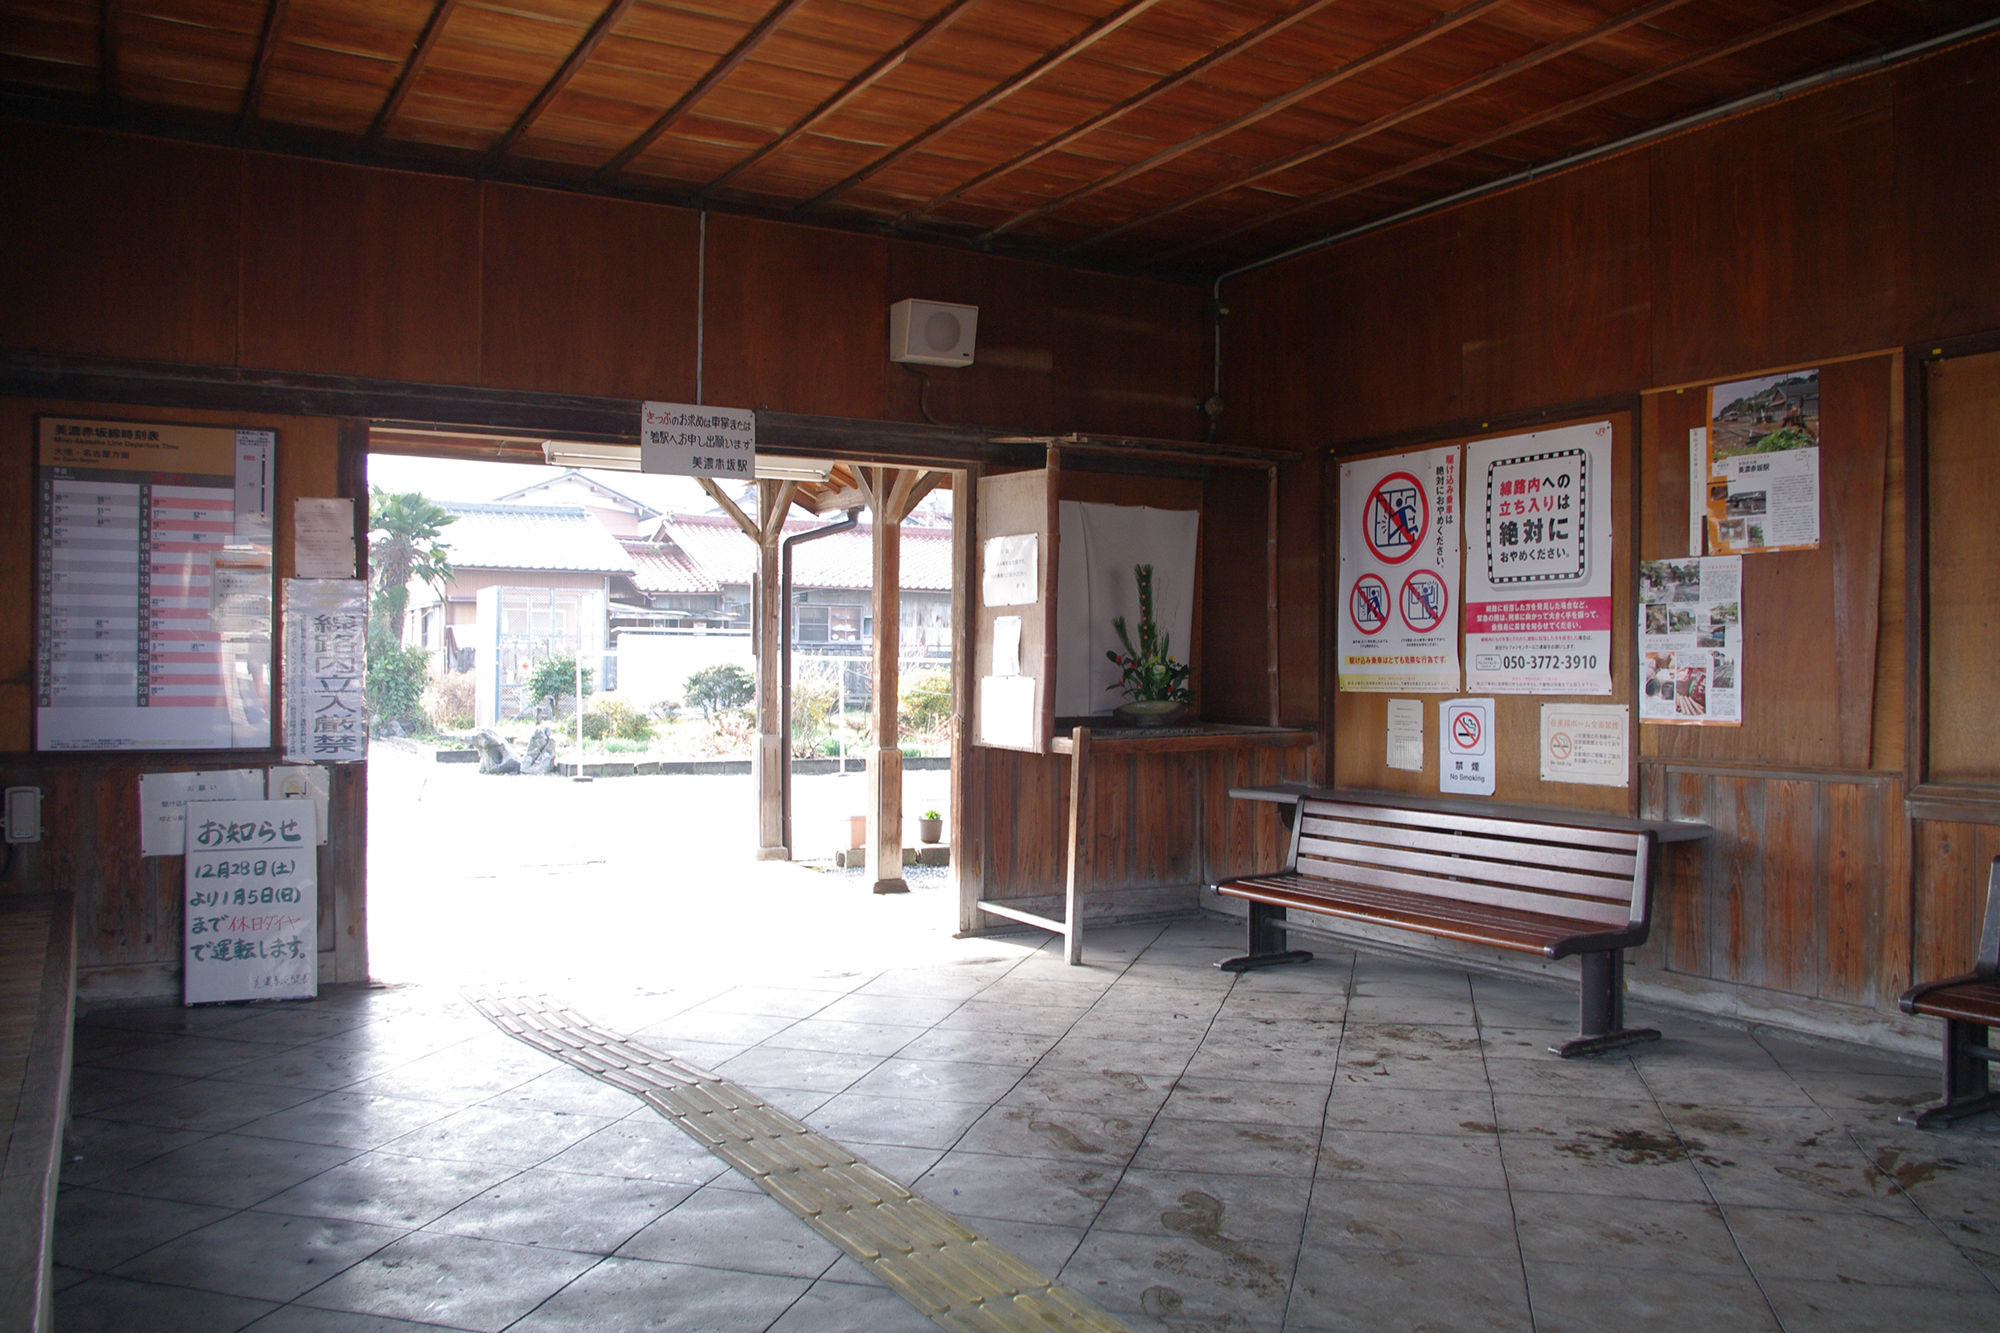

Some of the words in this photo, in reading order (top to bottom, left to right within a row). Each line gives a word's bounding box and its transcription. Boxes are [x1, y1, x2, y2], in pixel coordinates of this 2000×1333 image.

[646, 411, 751, 432] きっぷのお求めは車掌または
[650, 430, 750, 450] 着駅へお申し出願います
[692, 456, 748, 472] 美濃赤坂駅
[1738, 464, 1770, 474] 美濃赤坂駅
[1446, 454, 1454, 524] 駆け込み乗車は
[1500, 474, 1570, 496] 線路内への
[1499, 494, 1570, 516] 立ち入りは
[1436, 466, 1444, 568] 絶対におやめください。
[1499, 518, 1568, 546] 絶対に
[1500, 548, 1570, 563] おやめください。
[1349, 656, 1446, 665] 駆け込み乗車はとても危険な行為です。
[1503, 655, 1597, 669] 050-3772-3910
[314, 614, 357, 754] 線路内立入厳禁
[1551, 719, 1619, 730] 在来線ホーム全面禁煙
[1455, 761, 1480, 771] 禁煙
[1459, 774, 1485, 783] Smoking
[197, 818, 302, 847] お知らせ
[195, 860, 296, 880] 12月28日(土)
[190, 886, 302, 908] より1月5日(日)
[190, 934, 306, 962] で運転します。
